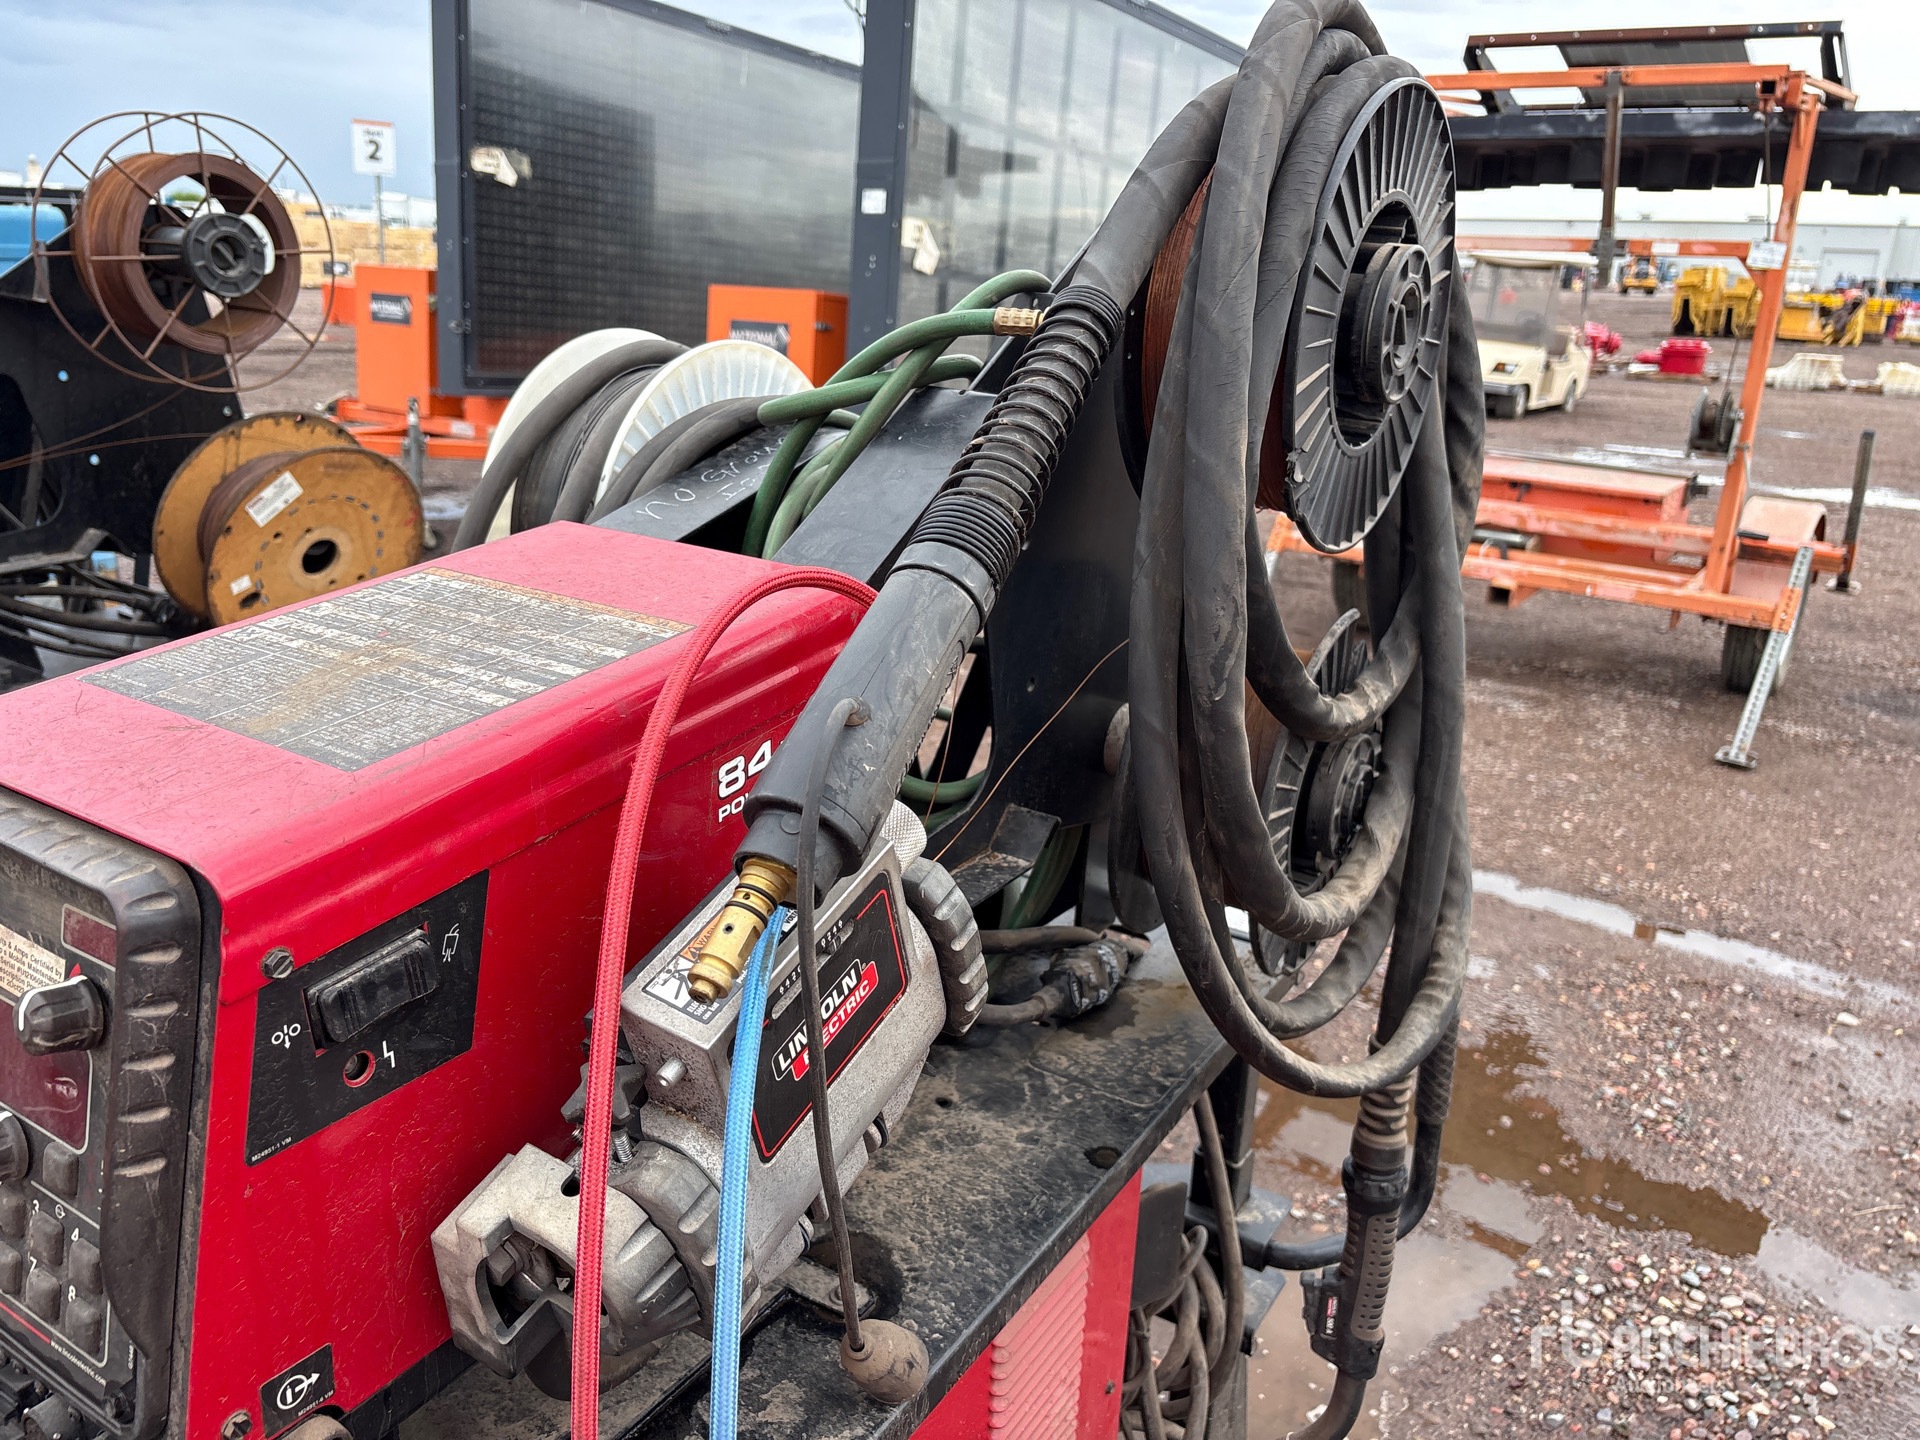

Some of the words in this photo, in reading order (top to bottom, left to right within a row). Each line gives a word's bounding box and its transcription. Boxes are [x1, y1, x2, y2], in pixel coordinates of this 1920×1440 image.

[365, 138, 383, 161] 2
[778, 967, 858, 1071] LINOLN
[803, 980, 870, 1066] EECTRIC
